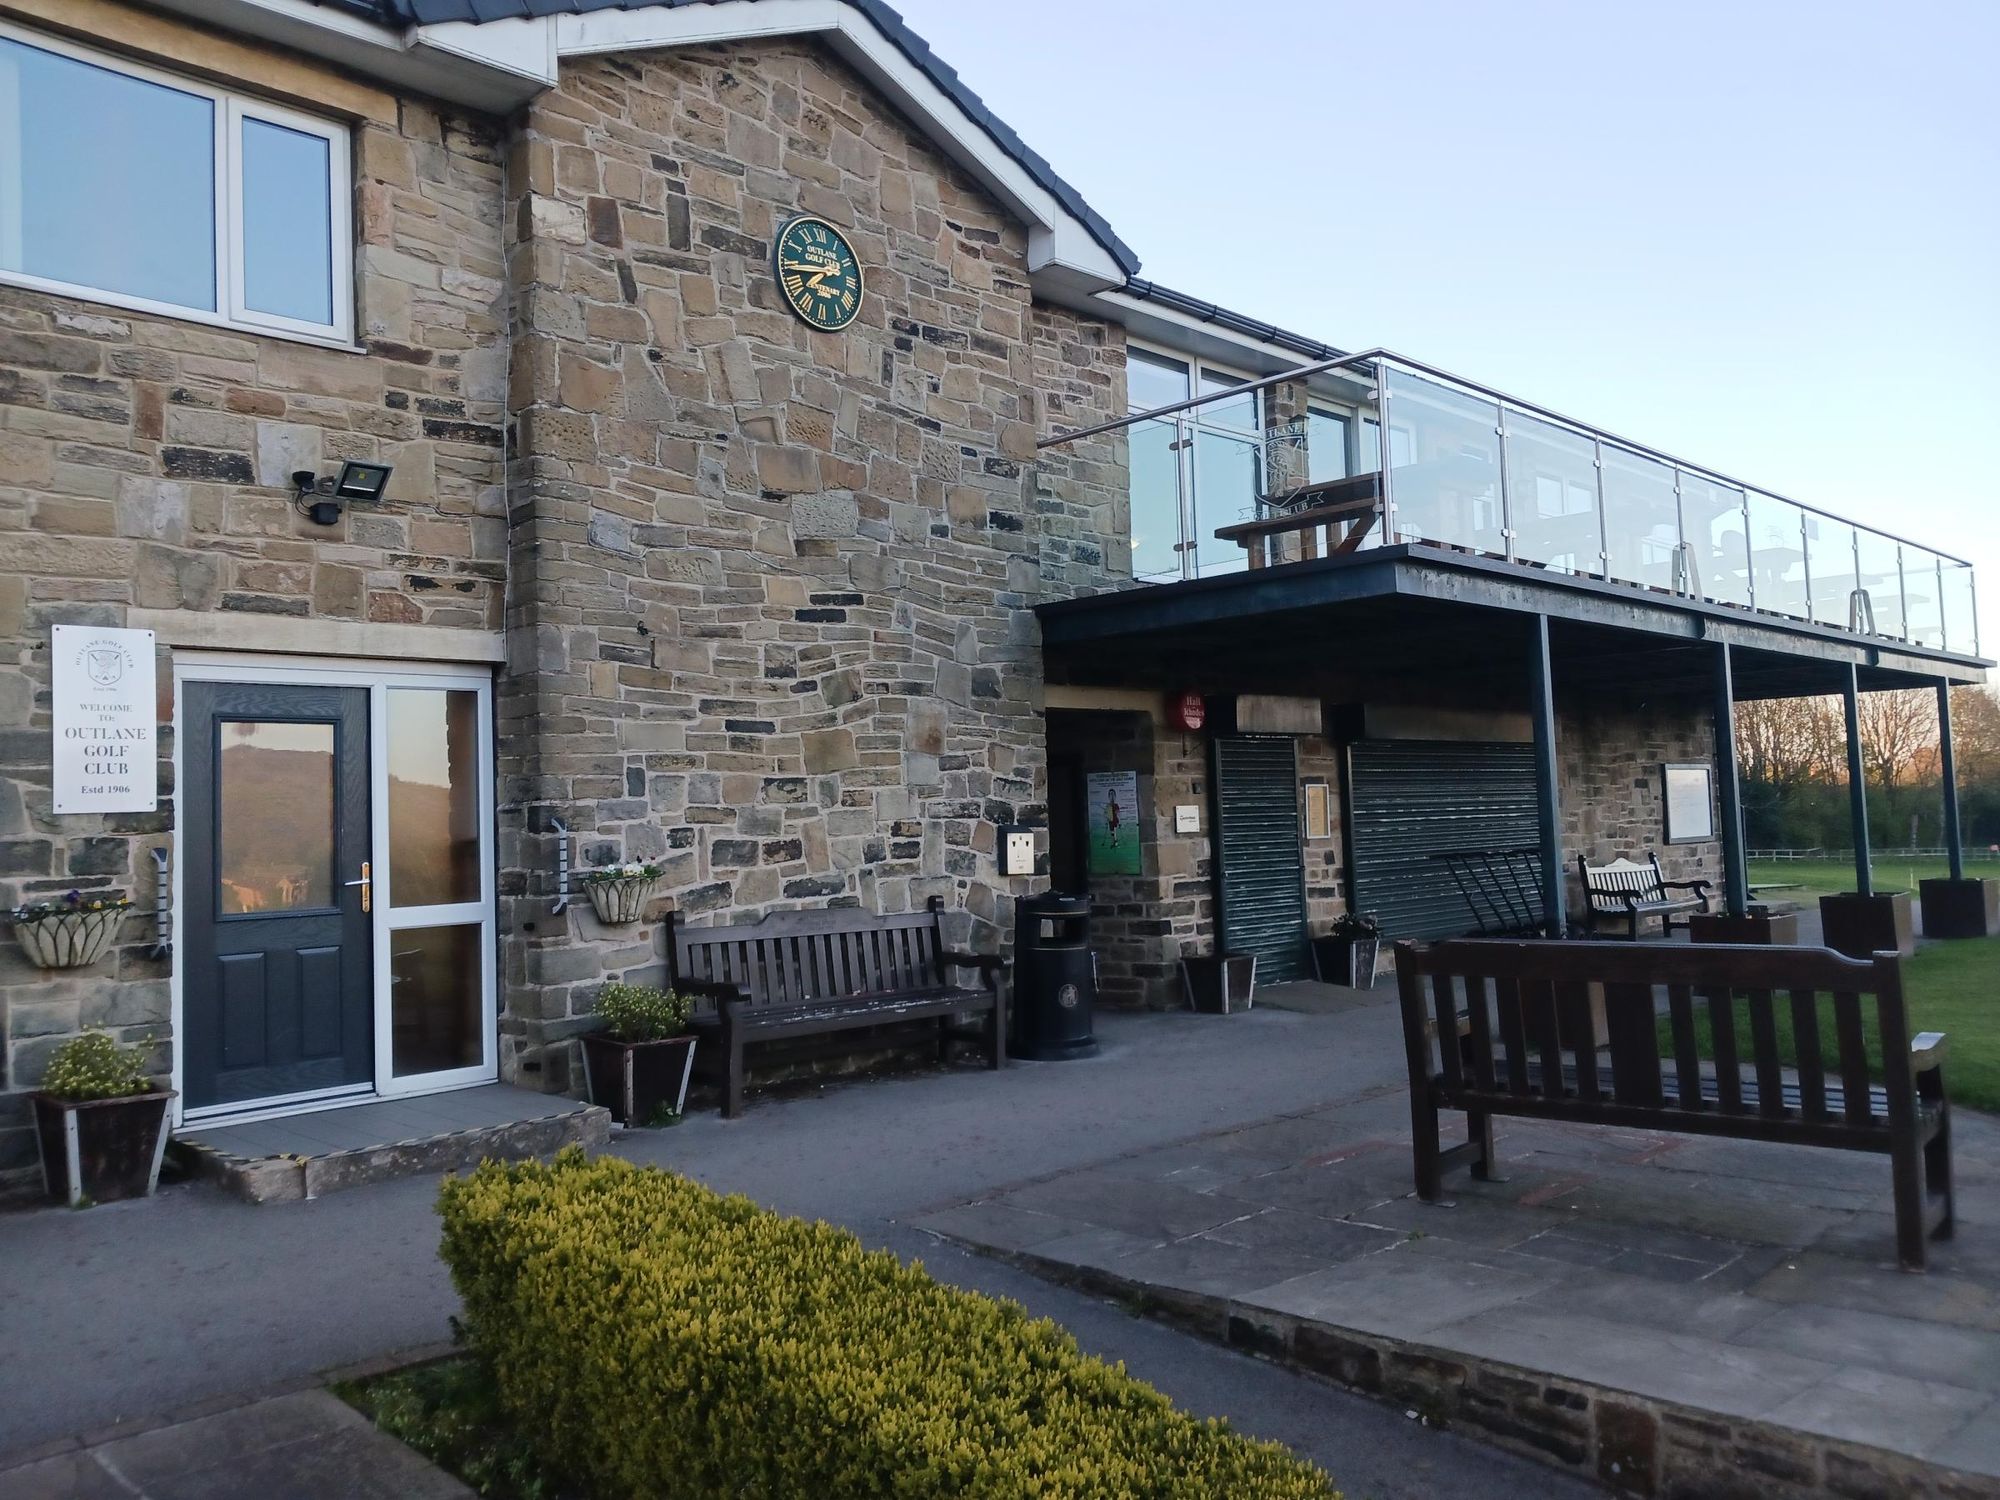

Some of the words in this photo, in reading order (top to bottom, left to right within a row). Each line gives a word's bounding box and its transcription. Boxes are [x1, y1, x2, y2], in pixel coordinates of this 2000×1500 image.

[805, 253, 823, 264] GOLF
[79, 703, 133, 712] WELCOME
[98, 714, 115, 722] TO:
[65, 727, 147, 740] OUTLANE
[84, 745, 129, 757] GOLF
[84, 762, 128, 775] CLUB
[81, 785, 104, 794] Estd
[107, 785, 131, 794] 1906
